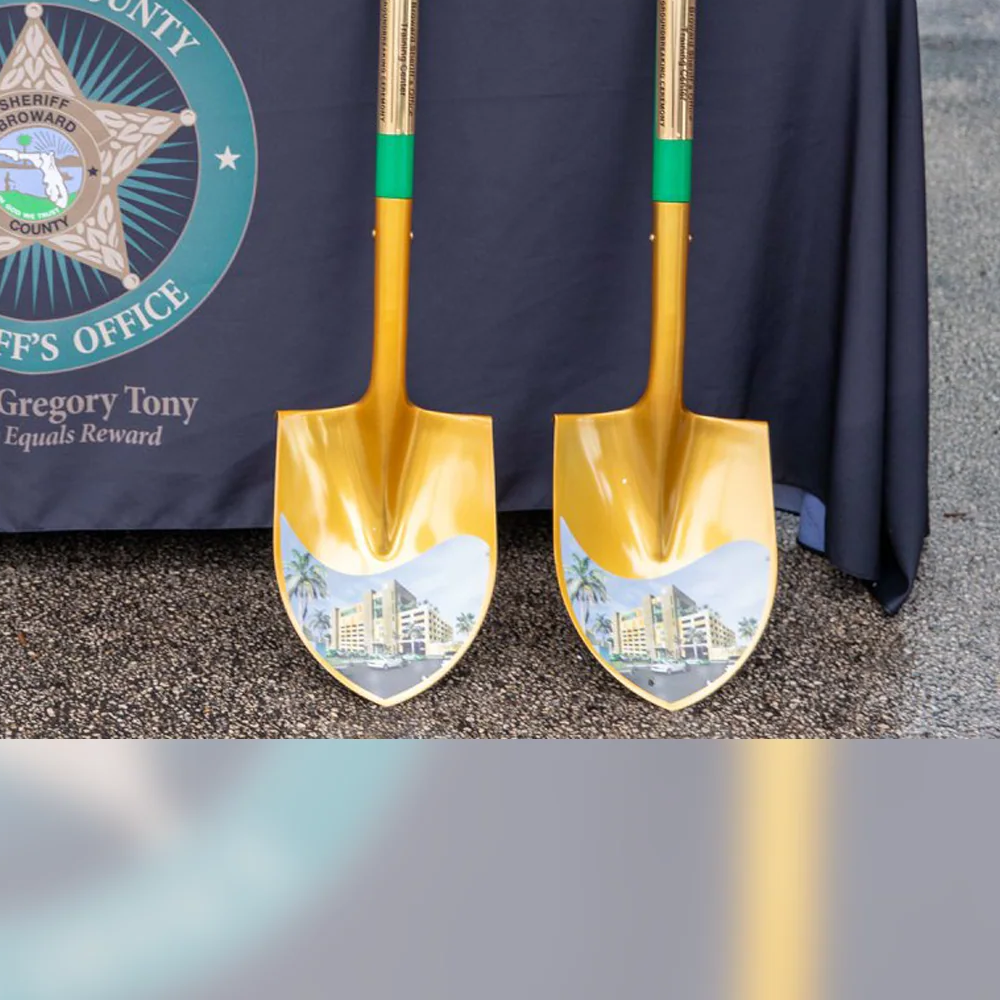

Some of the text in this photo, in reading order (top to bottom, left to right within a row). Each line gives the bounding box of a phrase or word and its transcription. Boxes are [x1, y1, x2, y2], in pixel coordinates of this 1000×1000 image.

[398, 22, 408, 96] Training Center
[5, 203, 22, 217] GOD
[23, 212, 36, 220] WE
[37, 207, 60, 219] TRUST
[9, 217, 69, 235] COUNTY
[73, 279, 190, 354] OFFICE
[124, 385, 199, 425] Tony
[4, 425, 75, 452] Equals
[80, 424, 163, 446] Reward
